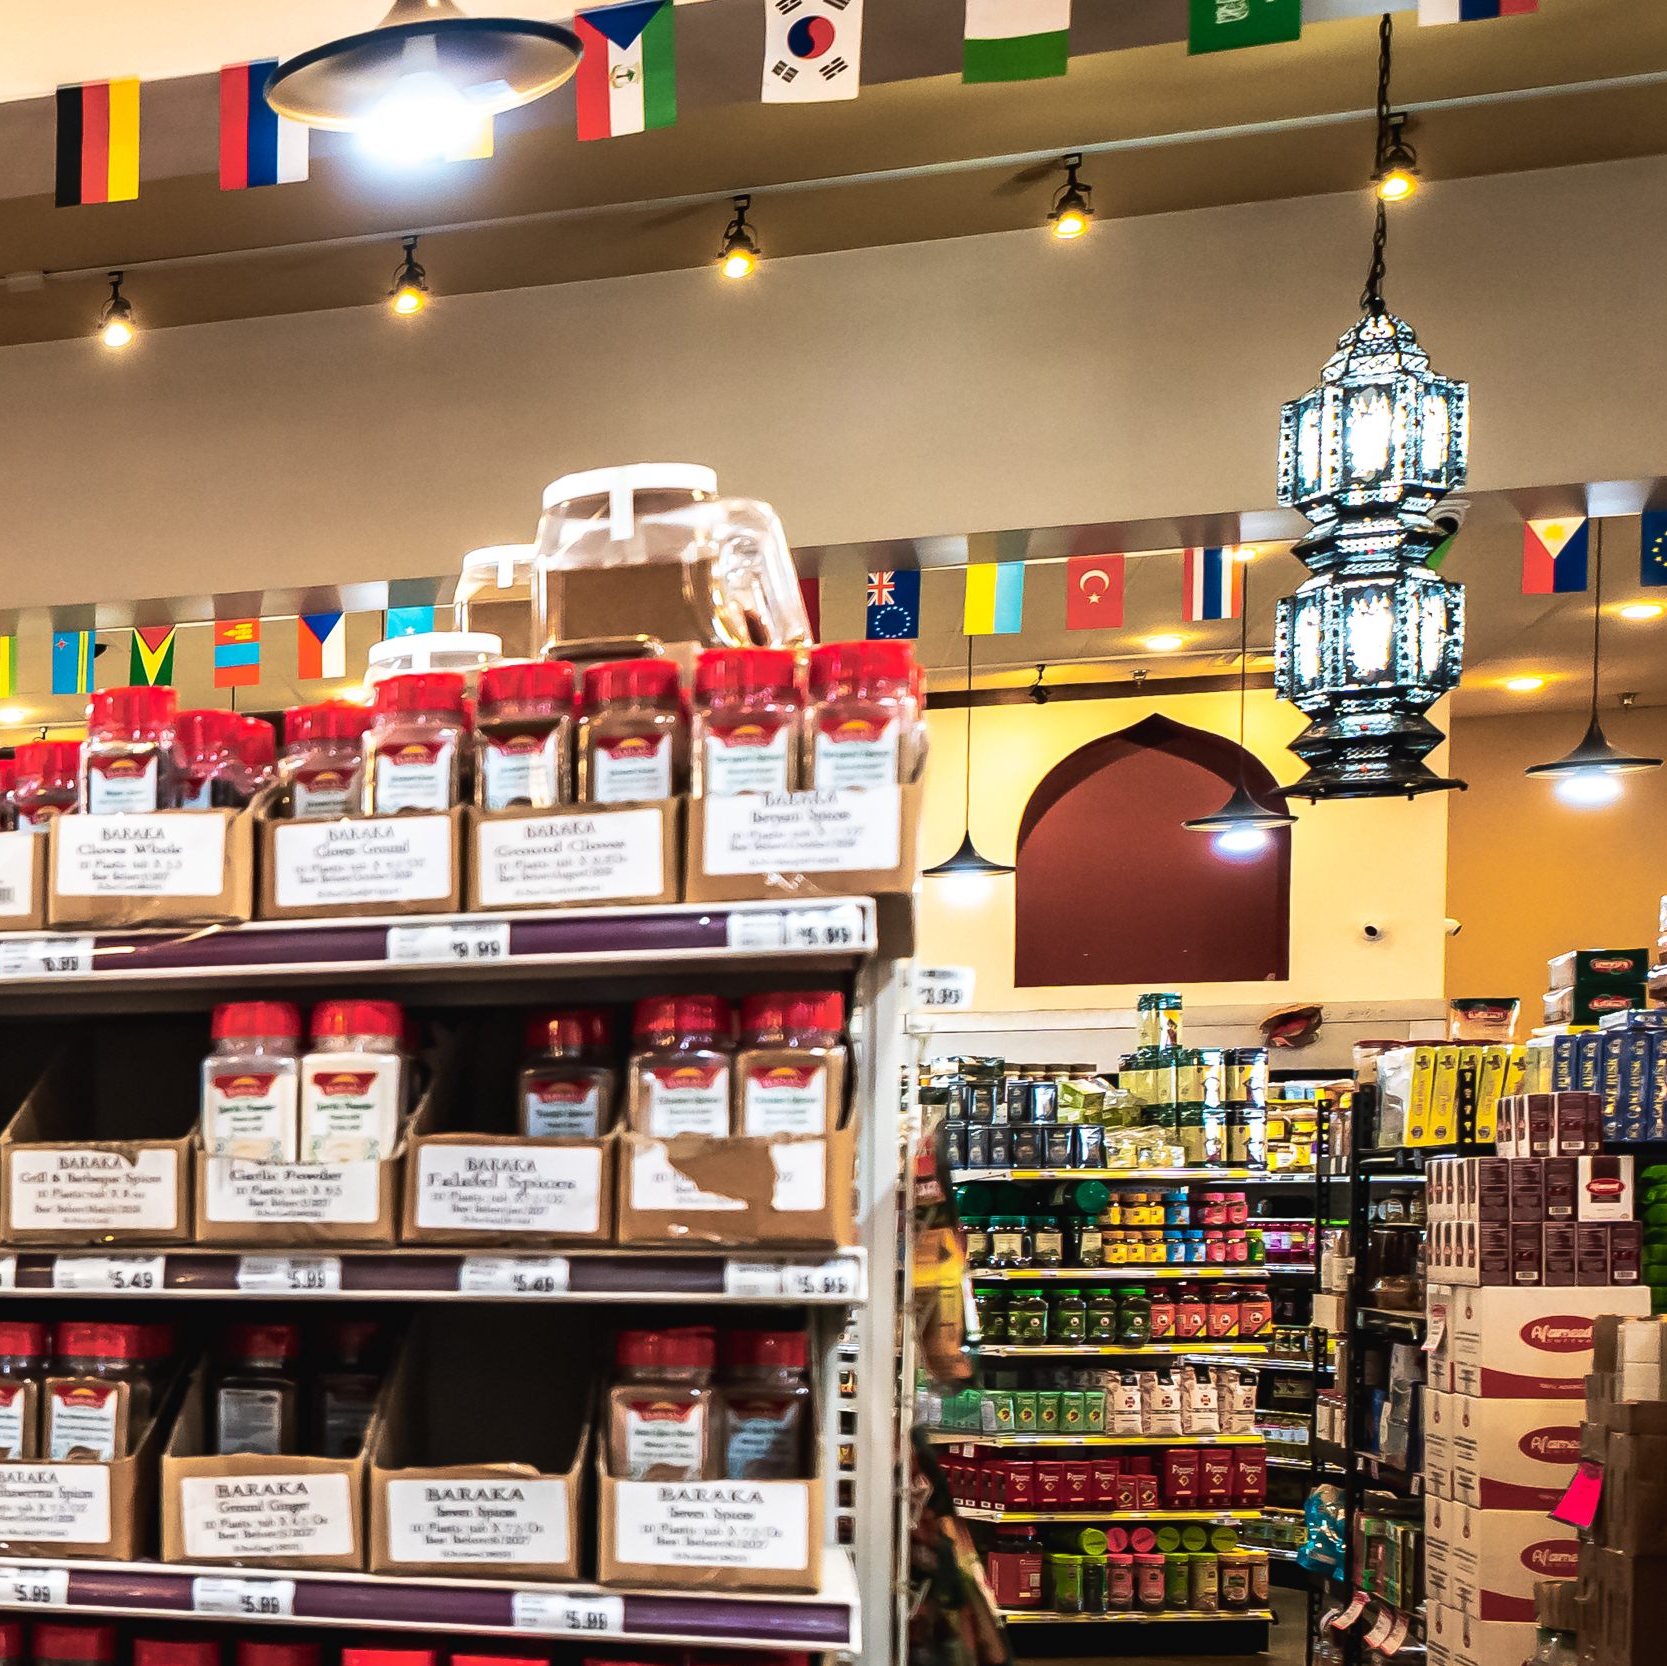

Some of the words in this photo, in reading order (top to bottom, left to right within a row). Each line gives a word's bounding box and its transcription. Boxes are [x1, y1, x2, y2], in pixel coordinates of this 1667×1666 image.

[1559, 1044, 1571, 1088] RUSK
[1606, 1055, 1620, 1084] RUSK
[1630, 1055, 1643, 1084] RUSK
[1606, 1086, 1617, 1117] CAKE
[1630, 1087, 1642, 1118] CAKE
[215, 1481, 309, 1498] BARAKA
[425, 1487, 525, 1502] BARAKA
[658, 1488, 764, 1504] BARAKA
